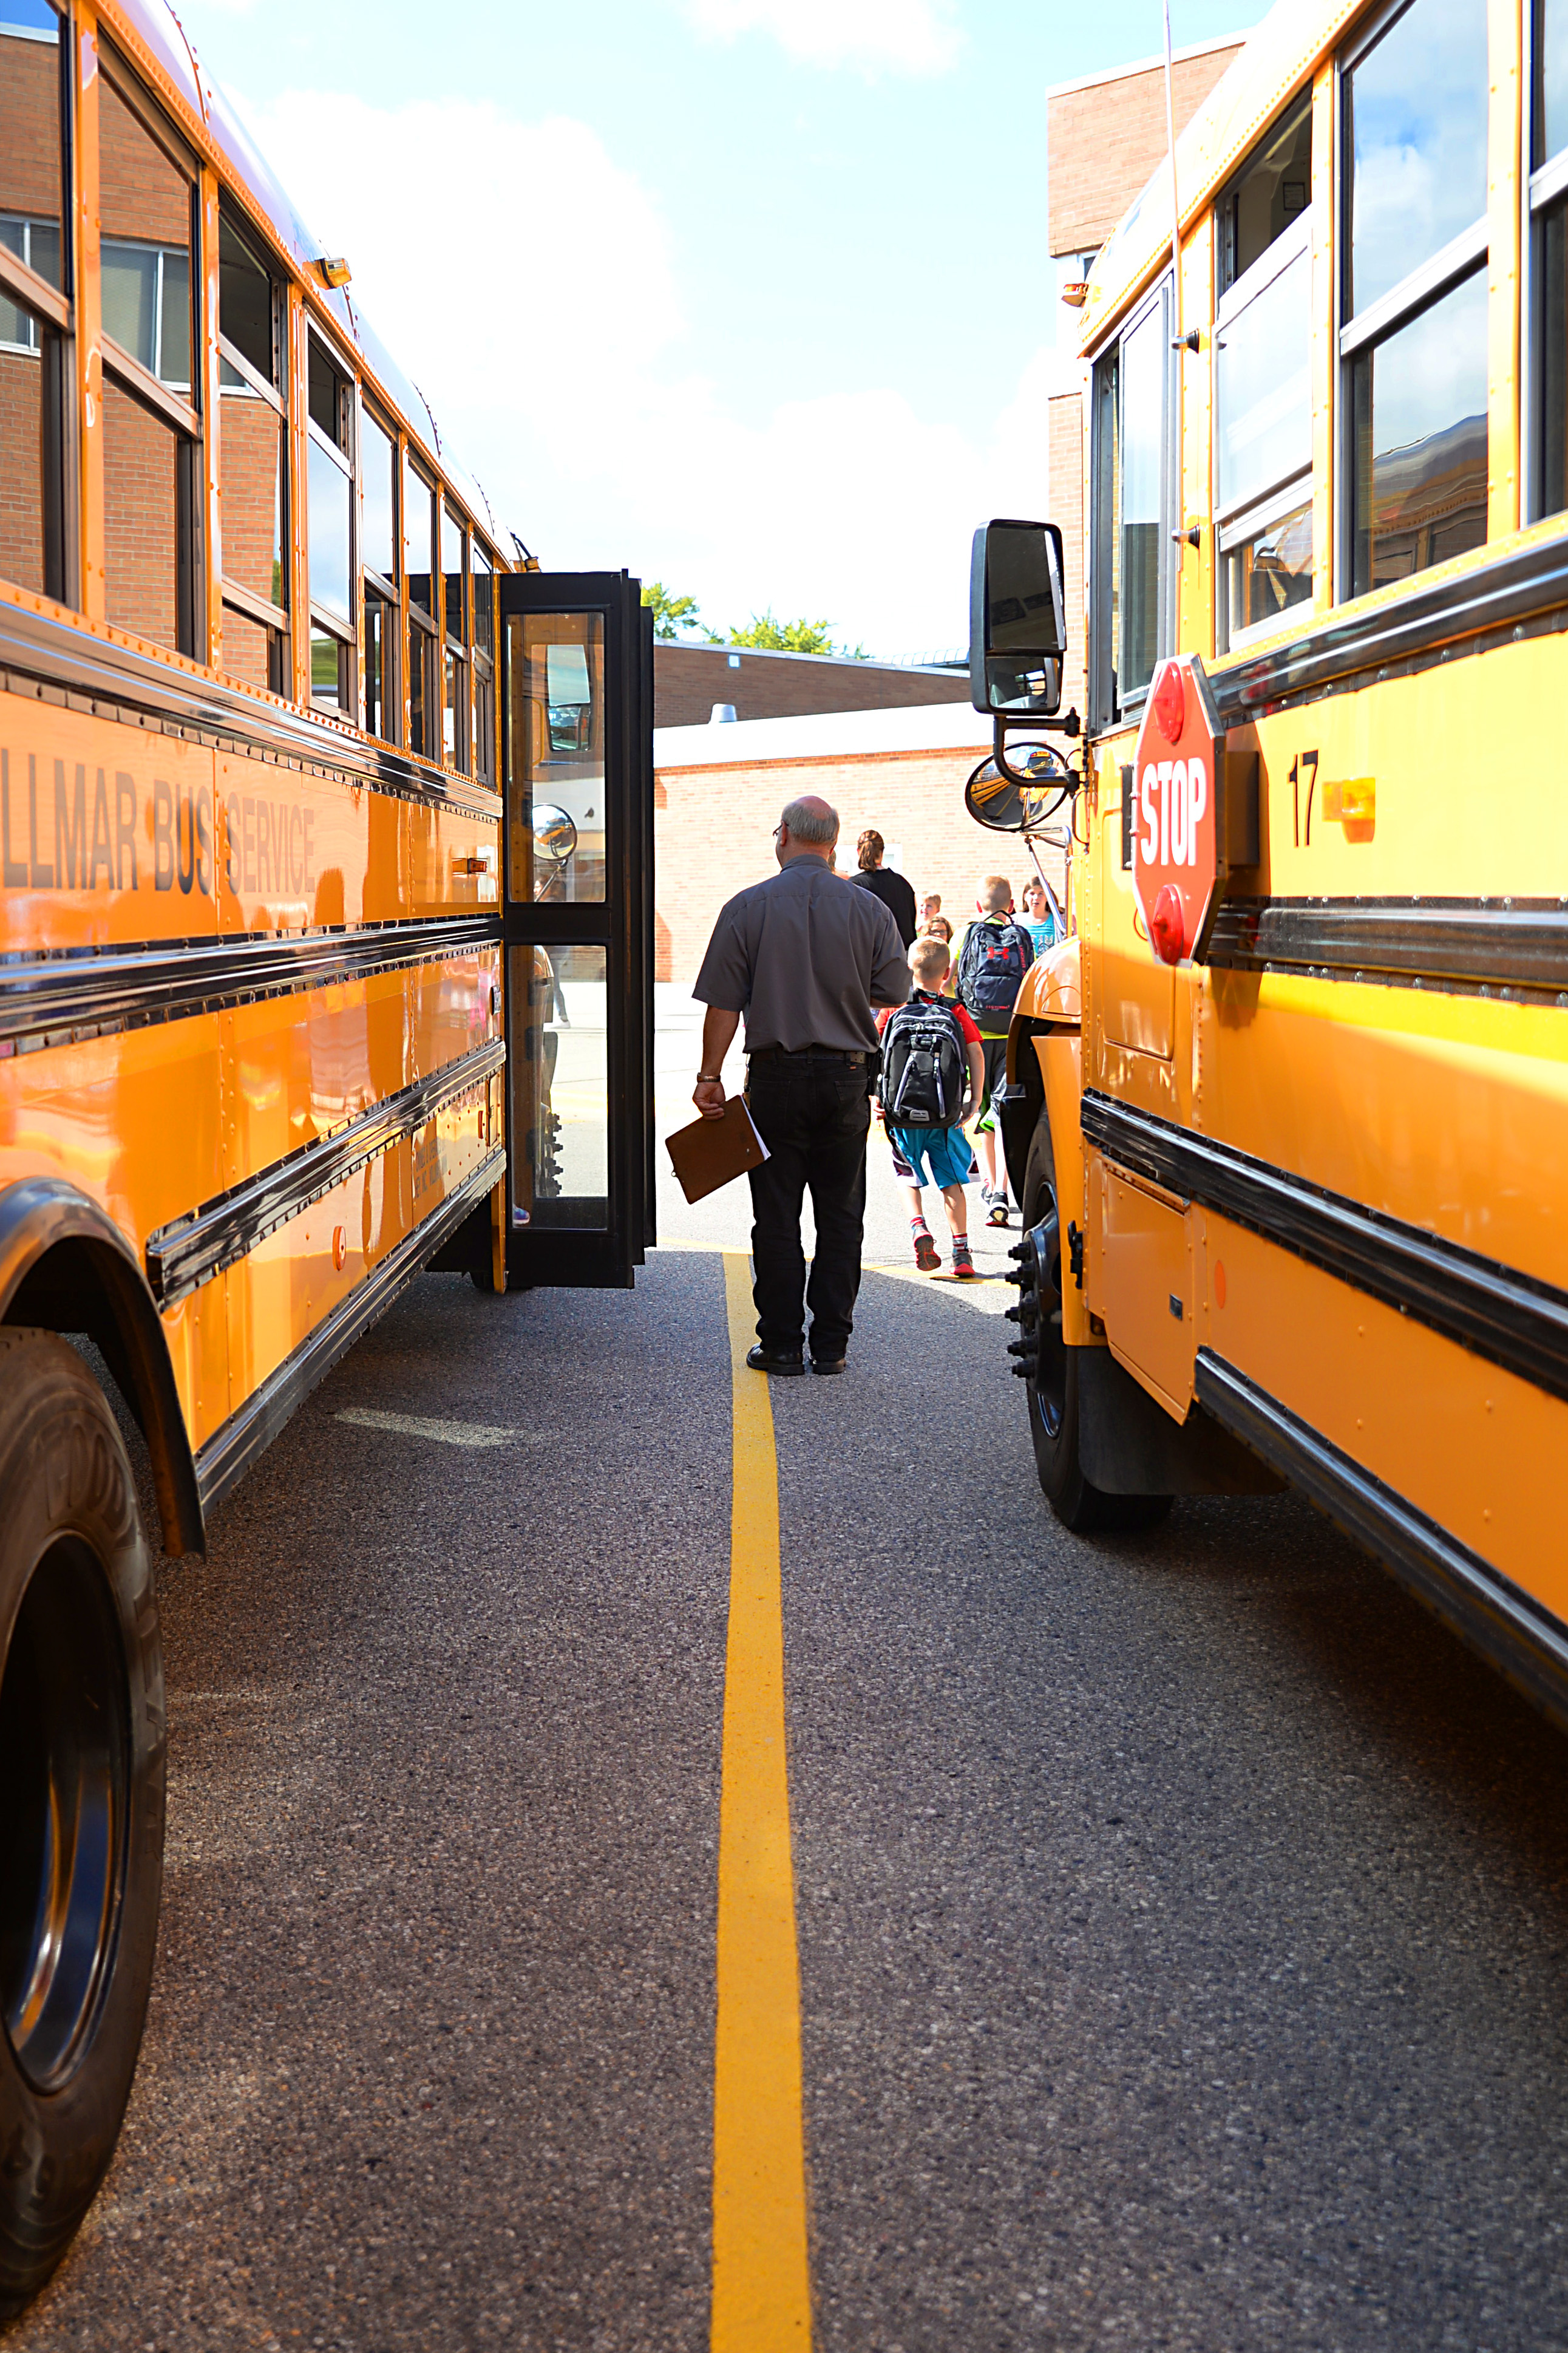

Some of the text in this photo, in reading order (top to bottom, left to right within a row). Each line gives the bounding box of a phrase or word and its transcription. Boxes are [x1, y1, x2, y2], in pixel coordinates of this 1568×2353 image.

[1, 748, 316, 896] LLMAR BUS SERVICE
[1141, 757, 1206, 867] STOP
[1287, 749, 1319, 848] 17
